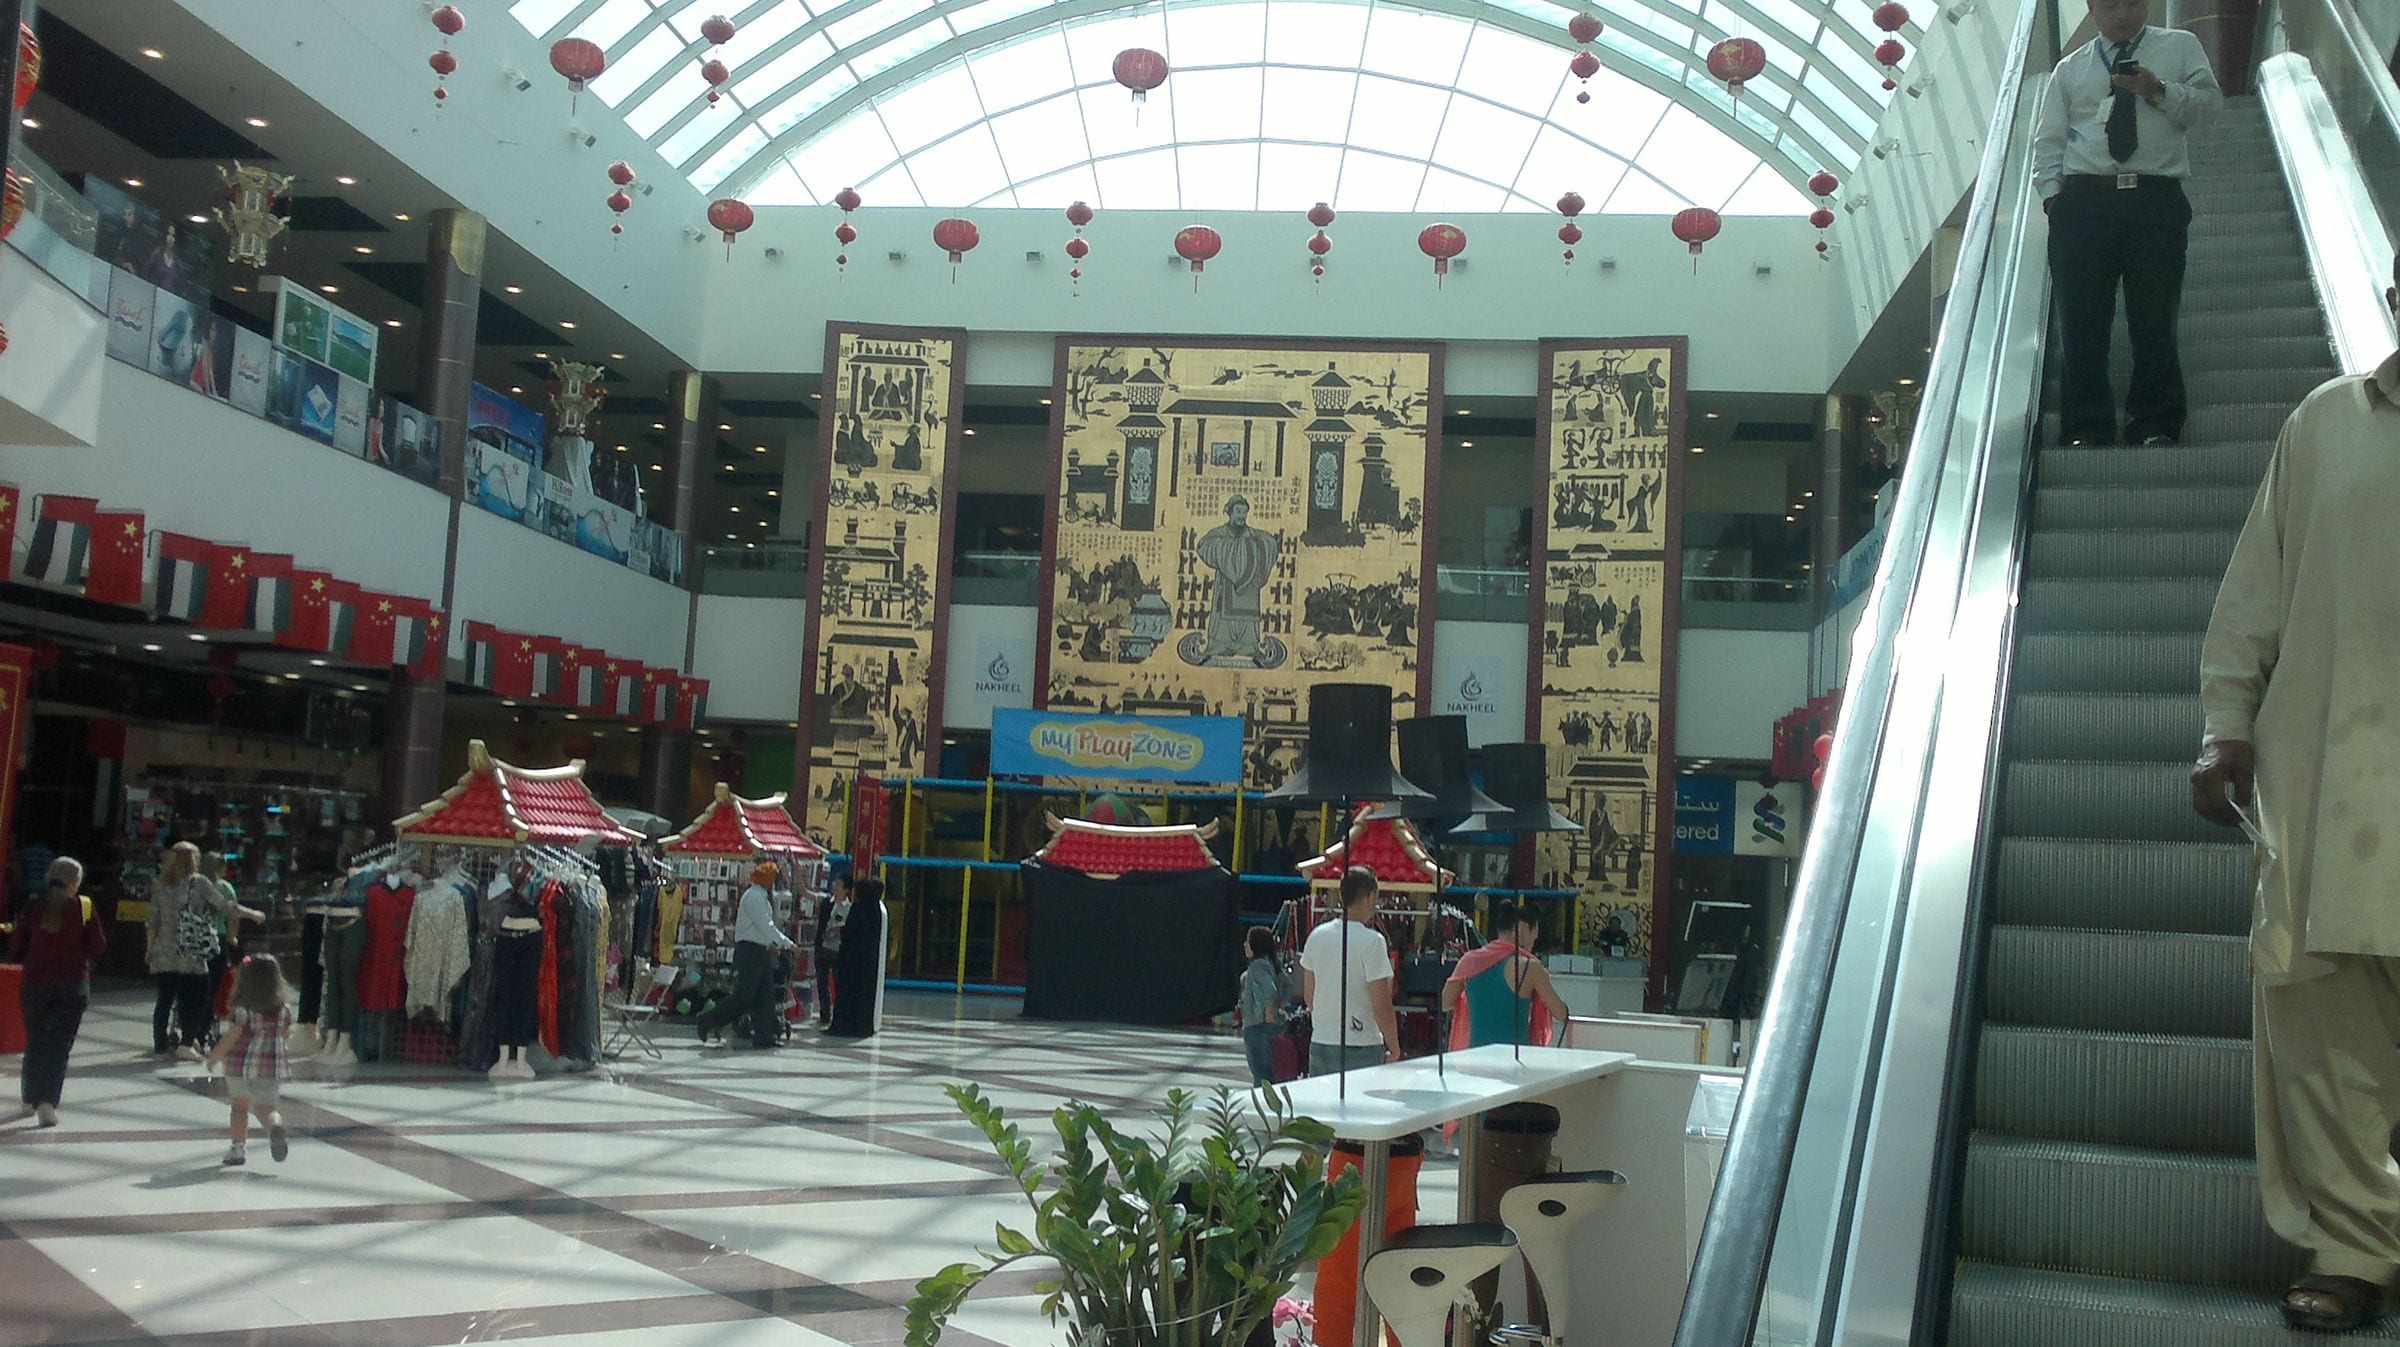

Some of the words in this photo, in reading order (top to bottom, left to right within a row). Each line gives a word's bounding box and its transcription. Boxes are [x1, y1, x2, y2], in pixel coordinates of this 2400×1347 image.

[975, 682, 1022, 693] NAKHEEL
[1447, 702, 1495, 713] NAKHEEL
[1674, 790, 1719, 812] ستا
[1674, 824, 1719, 841] ered
